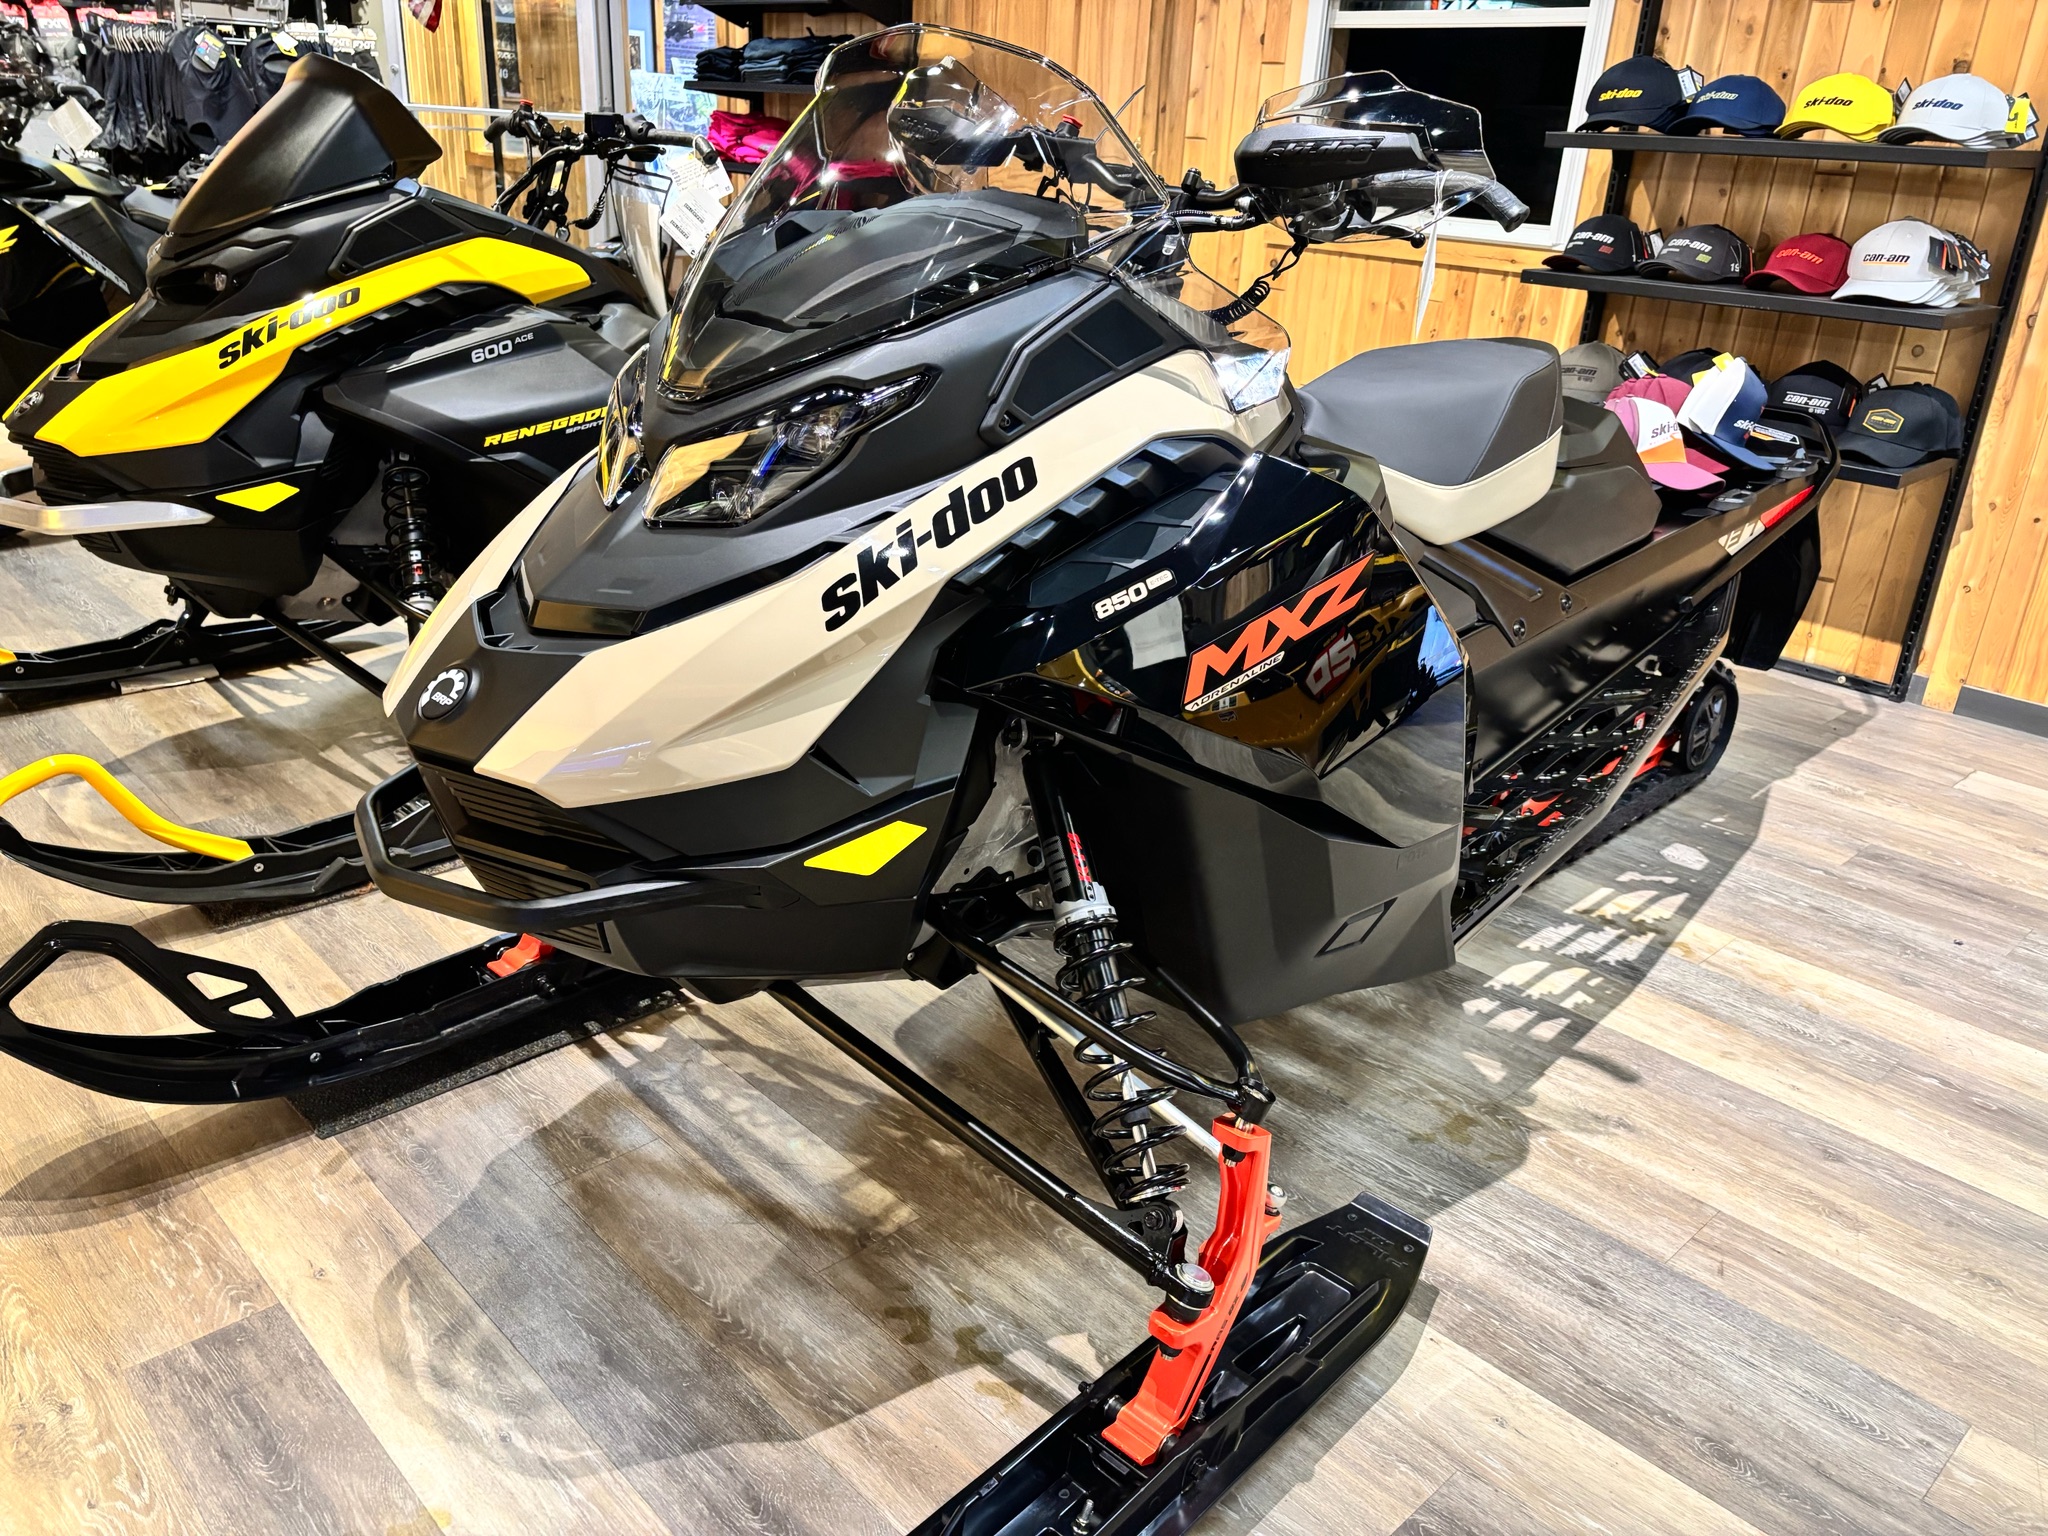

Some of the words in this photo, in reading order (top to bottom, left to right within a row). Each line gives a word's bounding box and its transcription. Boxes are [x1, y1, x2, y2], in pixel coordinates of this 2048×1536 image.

[1598, 87, 1643, 102] ski-doo
[1803, 96, 1854, 109] ski-doo
[1912, 98, 1964, 111] ski-doo
[1573, 231, 1615, 244] can-am
[1668, 238, 1713, 253] can-am
[1776, 248, 1825, 265] can-am
[1862, 253, 1911, 264] can-am
[218, 286, 362, 370] ski-doo
[470, 339, 513, 364] 600
[514, 332, 534, 345] ACE
[1784, 394, 1831, 408] can-am
[1651, 421, 1680, 439] ski-d
[820, 455, 1039, 633] ski-doo
[1094, 581, 1149, 620] 850
[1182, 551, 1375, 704] MXZ
[1189, 652, 1283, 711] ADRENALINE
[431, 691, 454, 706] BRP
